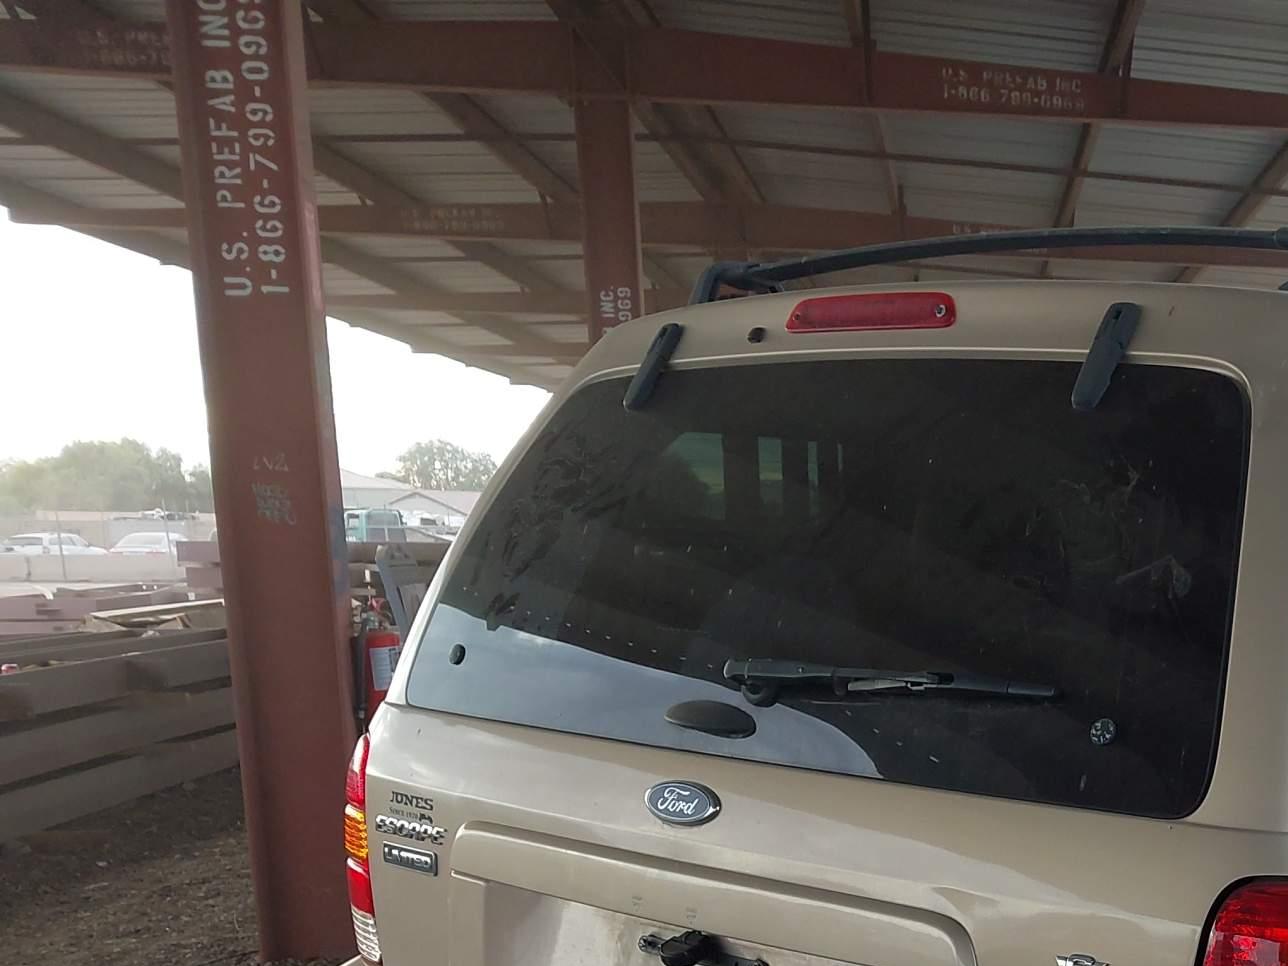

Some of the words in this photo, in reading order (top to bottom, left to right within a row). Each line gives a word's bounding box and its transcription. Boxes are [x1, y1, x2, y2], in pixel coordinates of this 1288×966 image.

[205, 69, 246, 208] PREFAB
[235, 0, 290, 293] 1-866-799-096
[221, 231, 253, 296] U.S.
[617, 287, 632, 321] 969
[657, 787, 699, 815] Ford
[376, 815, 447, 845] ESCAPE
